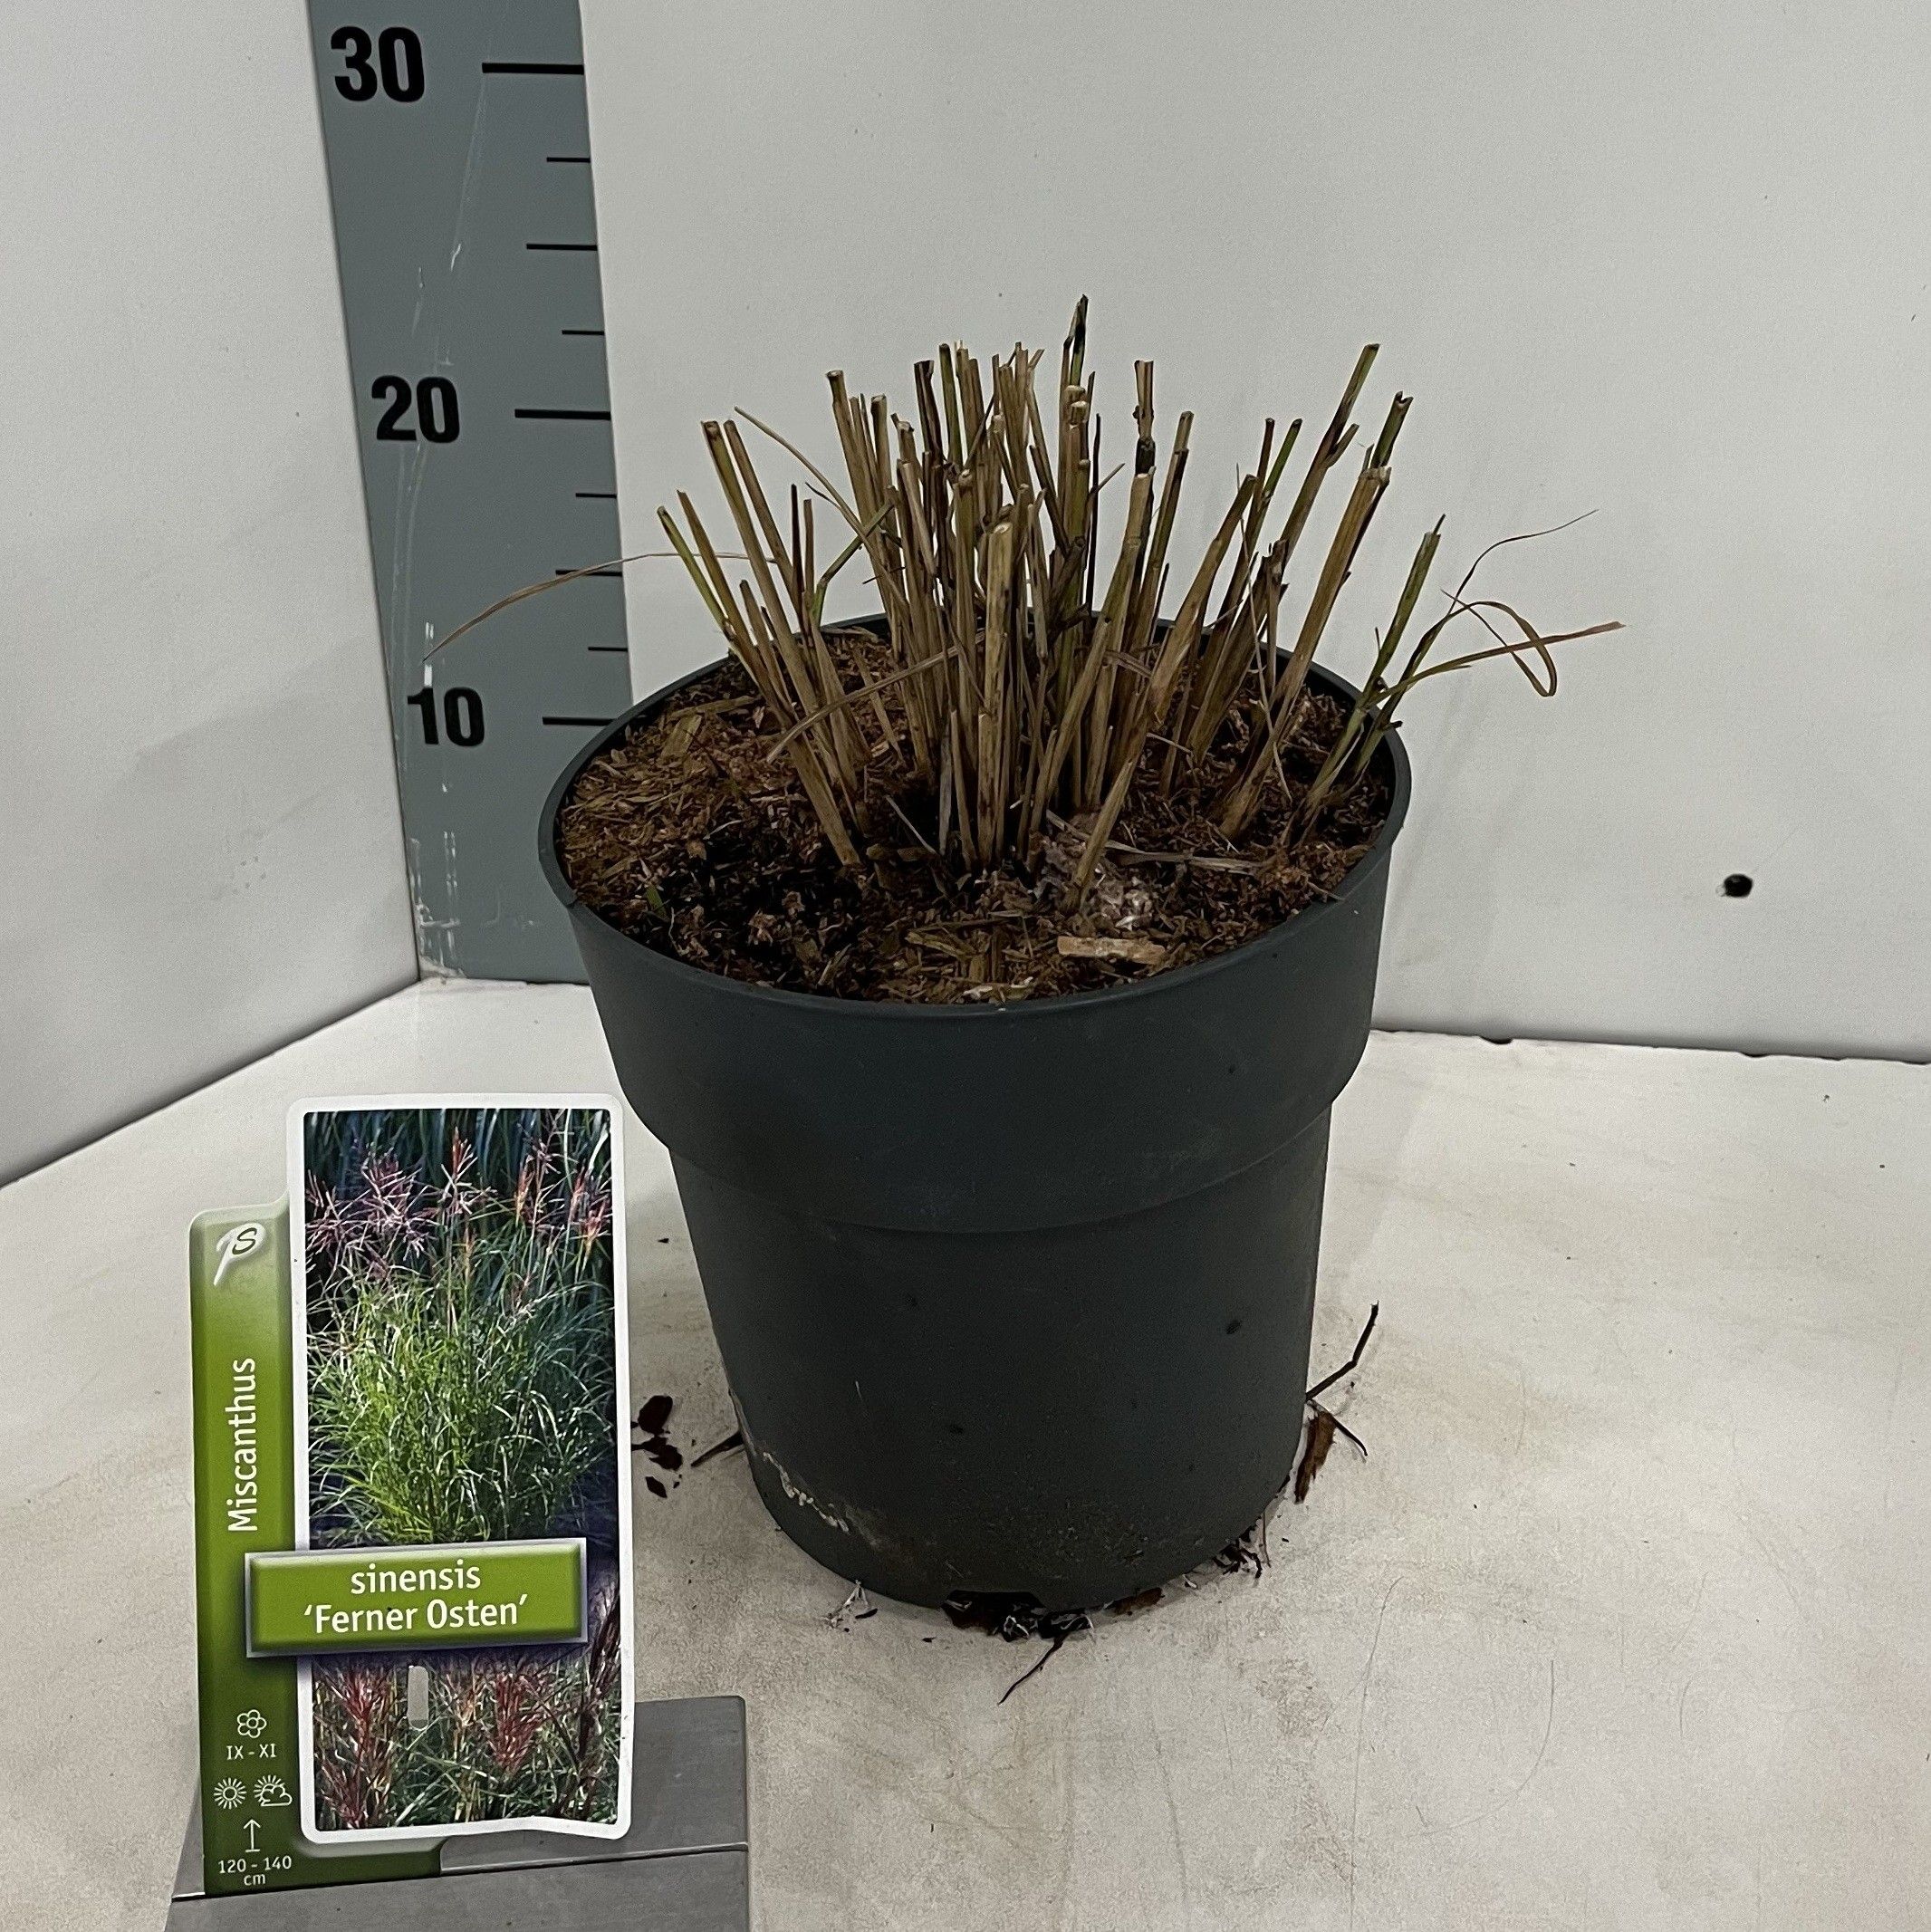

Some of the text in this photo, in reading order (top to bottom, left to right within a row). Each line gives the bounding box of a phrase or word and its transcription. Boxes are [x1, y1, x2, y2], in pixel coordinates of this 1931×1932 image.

[331, 26, 426, 102] 30
[371, 375, 460, 443] 20
[407, 687, 485, 746] 10
[226, 1357, 259, 1533] Miscanthus
[351, 1559, 482, 1595] sinensis
[226, 1745, 245, 1760] IX
[258, 1743, 277, 1759] XI
[218, 1860, 247, 1874] 120
[264, 1855, 293, 1871] 140
[244, 1873, 266, 1887] cm
